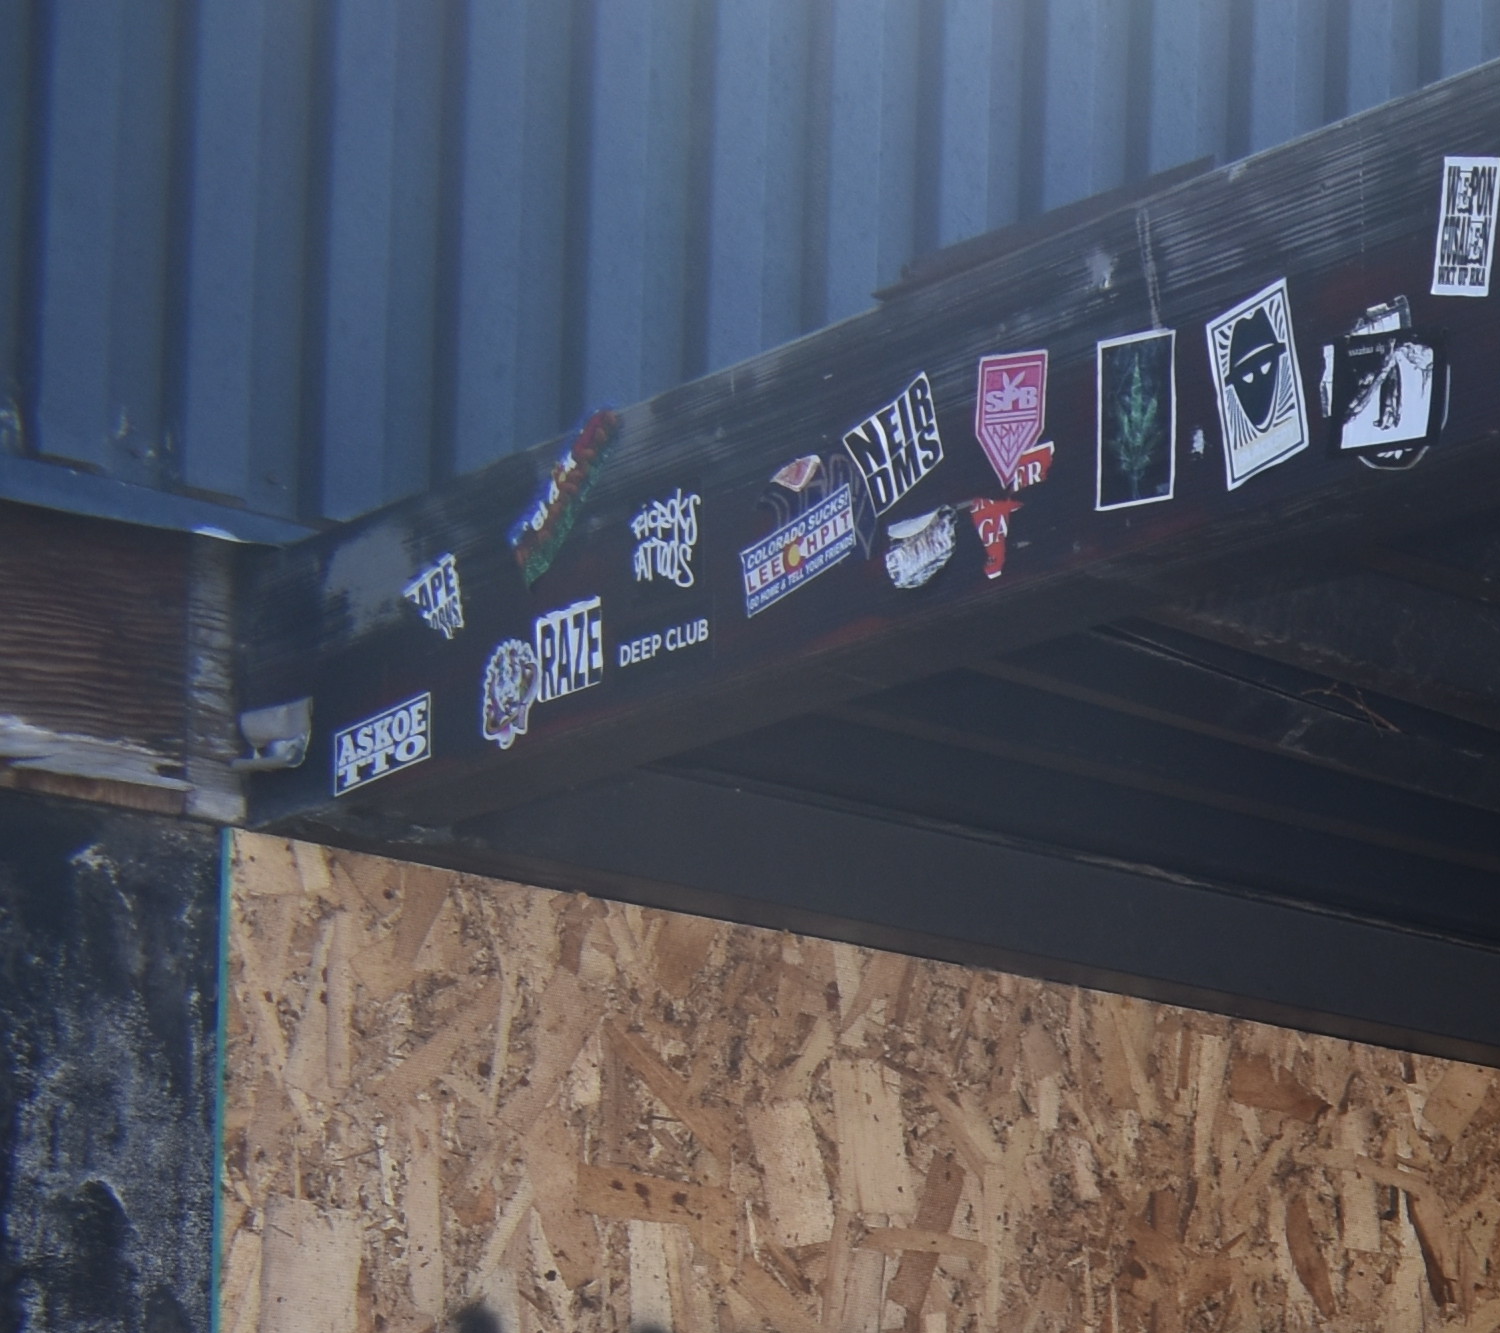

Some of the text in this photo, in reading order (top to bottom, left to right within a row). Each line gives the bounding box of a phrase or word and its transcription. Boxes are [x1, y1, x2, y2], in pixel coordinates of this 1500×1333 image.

[985, 386, 1038, 412] SPB
[747, 491, 848, 569] COLORADO SUCKS!
[619, 619, 709, 667] DEEP CLUB
[339, 700, 427, 766] ASKOE
